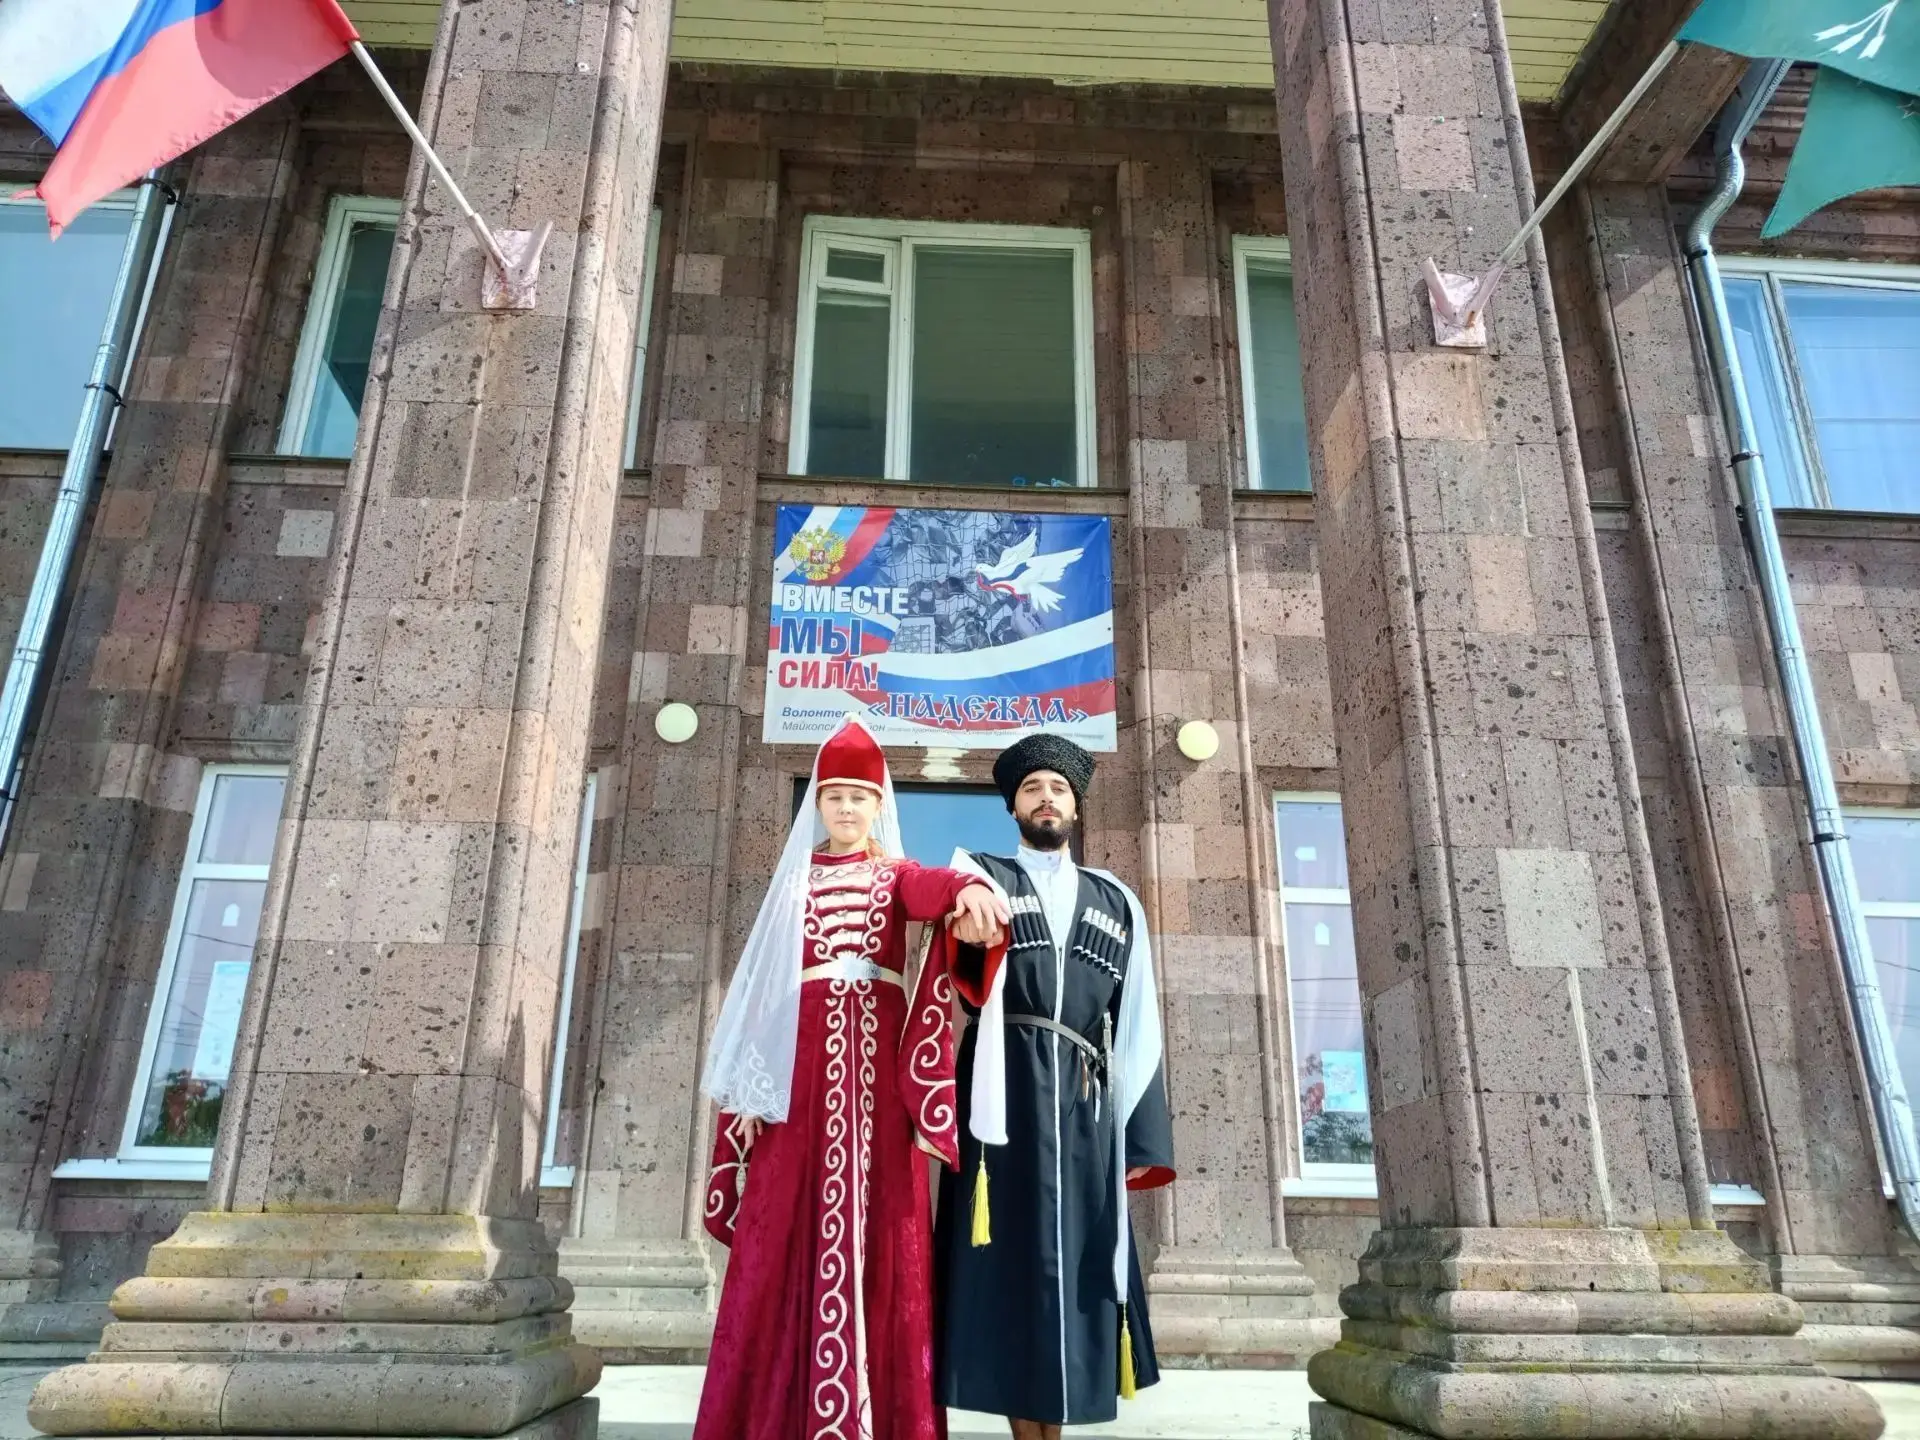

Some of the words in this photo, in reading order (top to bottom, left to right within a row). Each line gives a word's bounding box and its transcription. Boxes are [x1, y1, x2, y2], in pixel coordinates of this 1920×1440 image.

[782, 584, 909, 614] ВМЕСТЕ
[780, 617, 861, 656] МЫ
[778, 660, 878, 690] СИЛА!
[782, 706, 863, 717] Волонте
[782, 721, 836, 731] Майкопск
